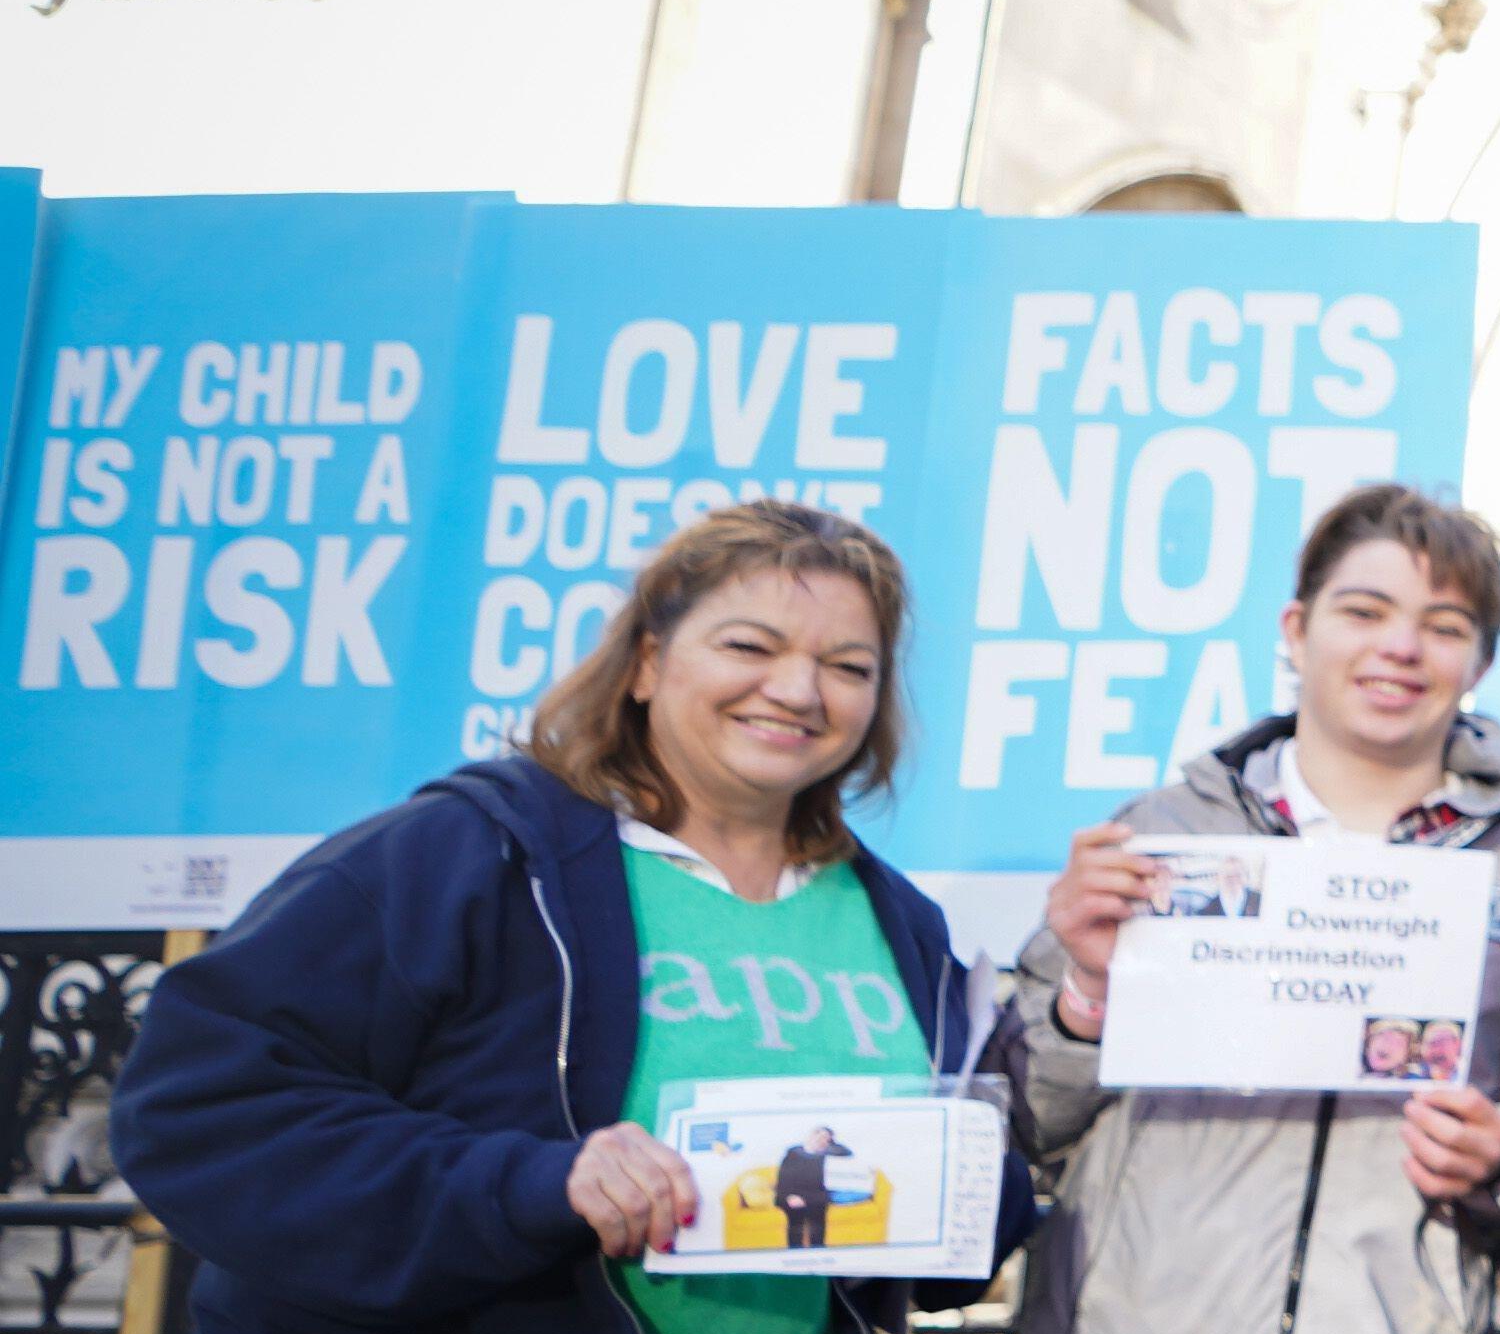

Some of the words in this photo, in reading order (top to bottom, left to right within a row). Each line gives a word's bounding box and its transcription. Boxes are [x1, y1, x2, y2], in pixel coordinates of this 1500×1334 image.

[48, 346, 162, 429] MY
[180, 341, 423, 427] CHILD
[497, 315, 899, 471] LOVE
[1003, 287, 1402, 418] FACTS
[36, 438, 134, 529] IS
[157, 435, 334, 526] NOT
[356, 435, 411, 524] A
[975, 422, 1398, 634] NOT
[20, 534, 408, 690] RISK
[958, 639, 1300, 790] FEA
[1285, 907, 1440, 938] Downright
[1326, 874, 1411, 902] STOP
[1190, 941, 1405, 970] Discrimination
[1269, 977, 1373, 1005] TODAY
